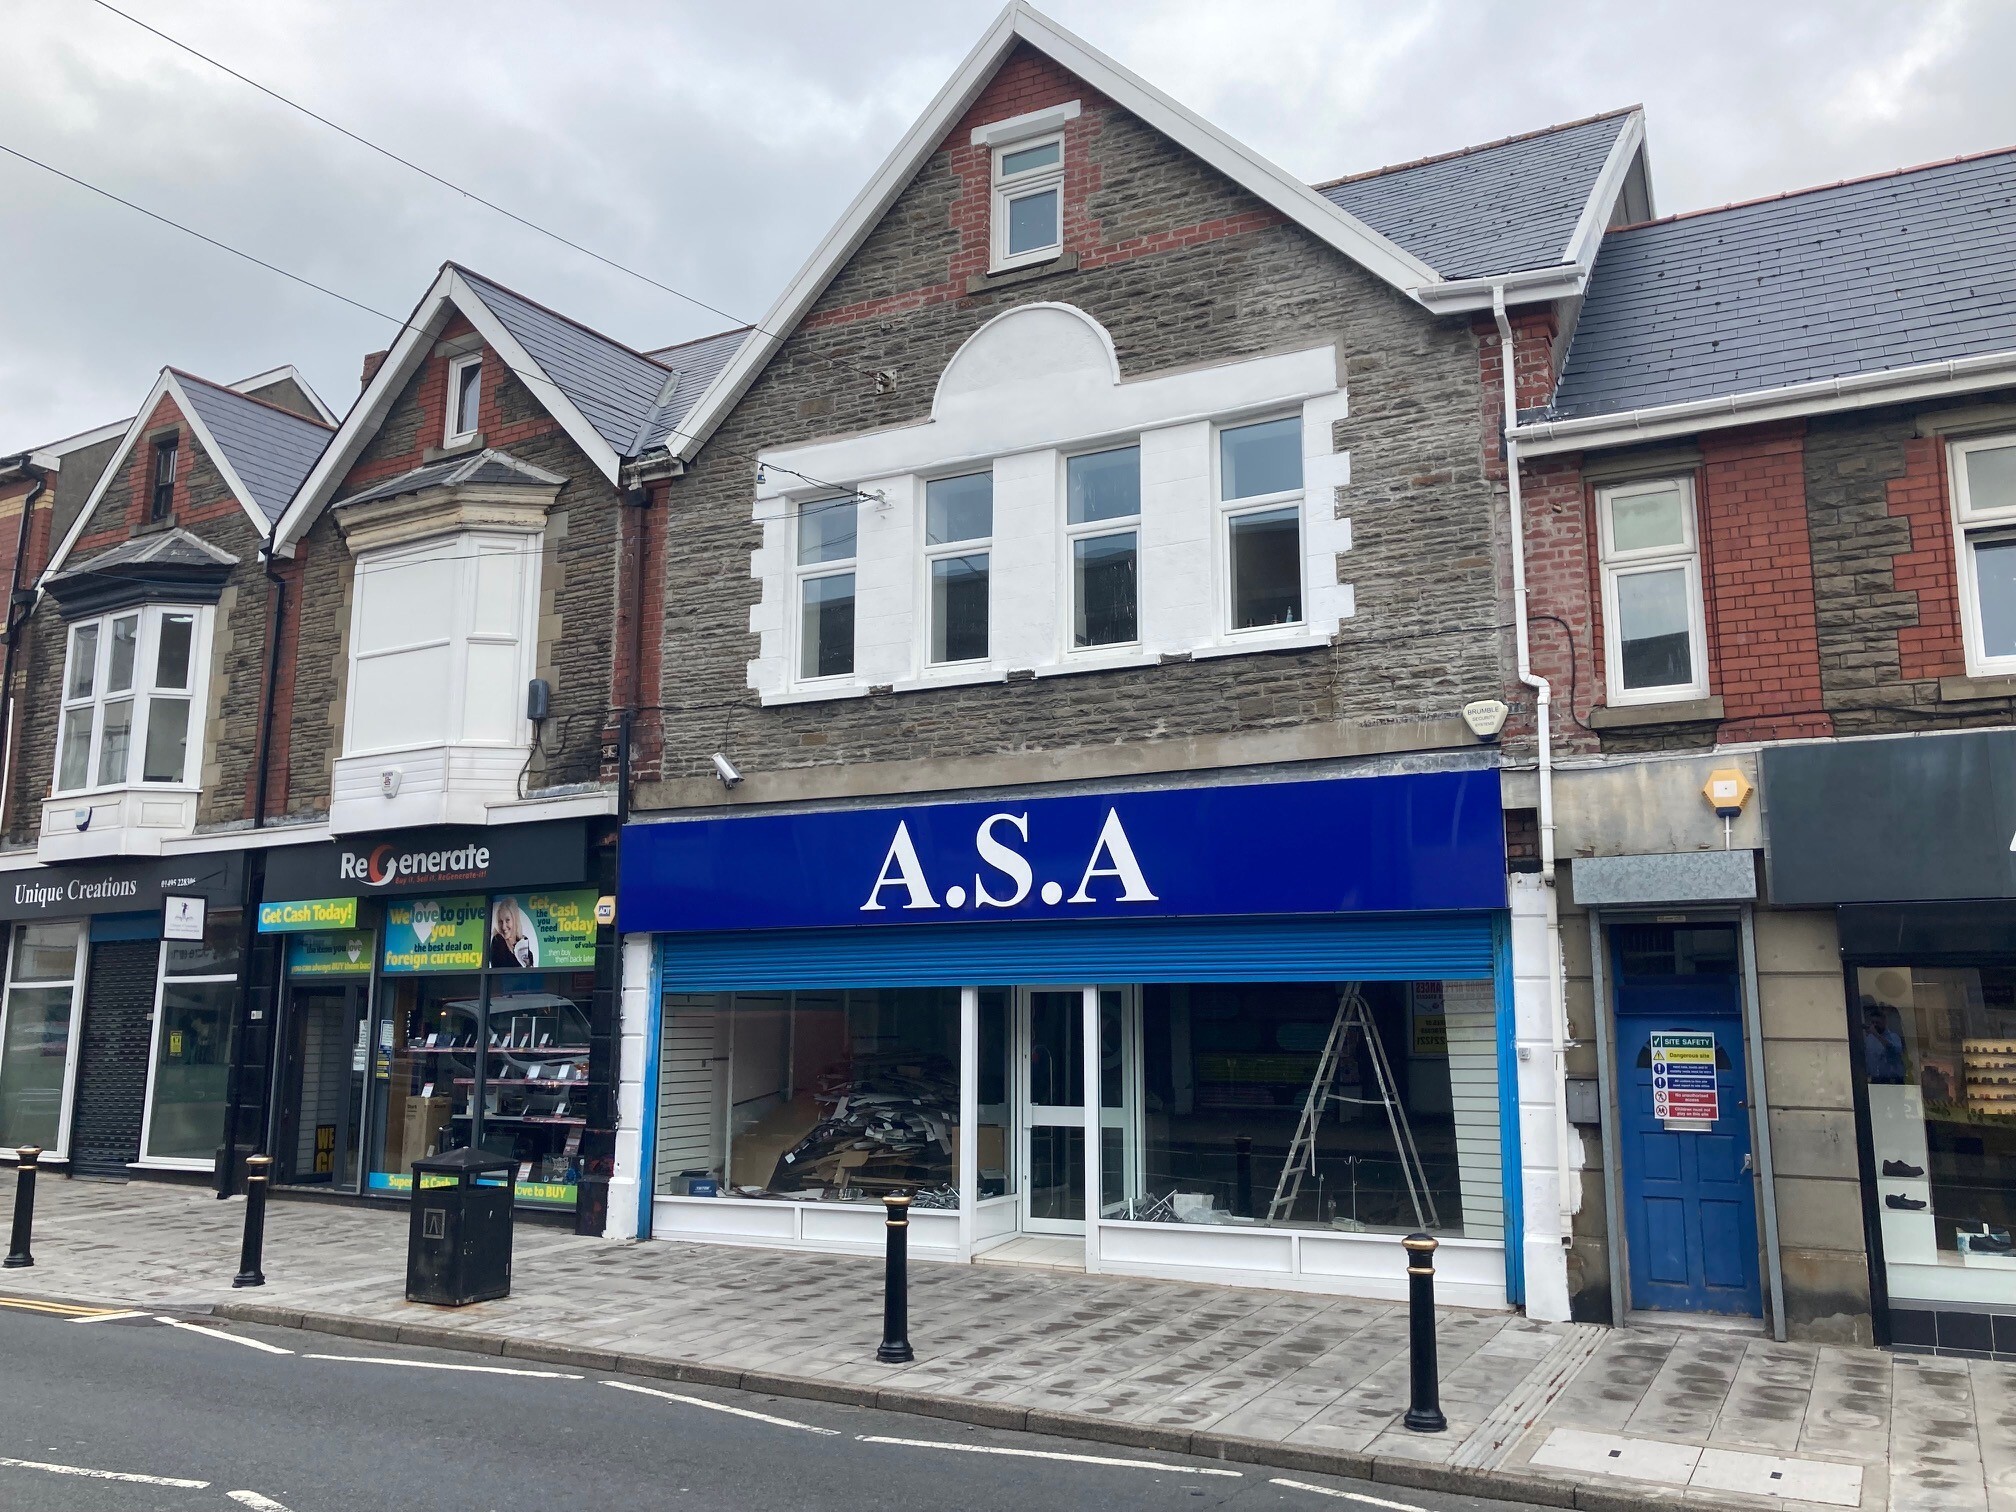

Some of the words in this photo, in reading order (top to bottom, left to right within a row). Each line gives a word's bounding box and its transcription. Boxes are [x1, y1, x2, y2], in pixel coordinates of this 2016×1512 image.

[1467, 706, 1499, 715] BRUMBLE
[859, 806, 1160, 911] A.S.A
[15, 882, 64, 908] Unique
[67, 876, 137, 900] Creations
[529, 895, 550, 910] Get
[262, 908, 281, 924] Get
[283, 905, 311, 922] Cash
[312, 903, 352, 924] Today!
[390, 908, 410, 925] We
[411, 906, 439, 923] love
[441, 905, 454, 922] to
[537, 908, 548, 918] the
[549, 902, 579, 918] Cash
[537, 918, 551, 927] you
[540, 923, 557, 933] need
[430, 924, 456, 943] you
[557, 936, 570, 944] your
[414, 943, 427, 953] the
[427, 942, 443, 952] best
[445, 942, 461, 951] deal
[463, 943, 473, 951] on
[386, 950, 428, 970] foreign
[430, 951, 483, 968] currency
[1682, 1038, 1710, 1046] SAFETY
[534, 1186, 545, 1198] to
[545, 1186, 566, 1198] BUY
